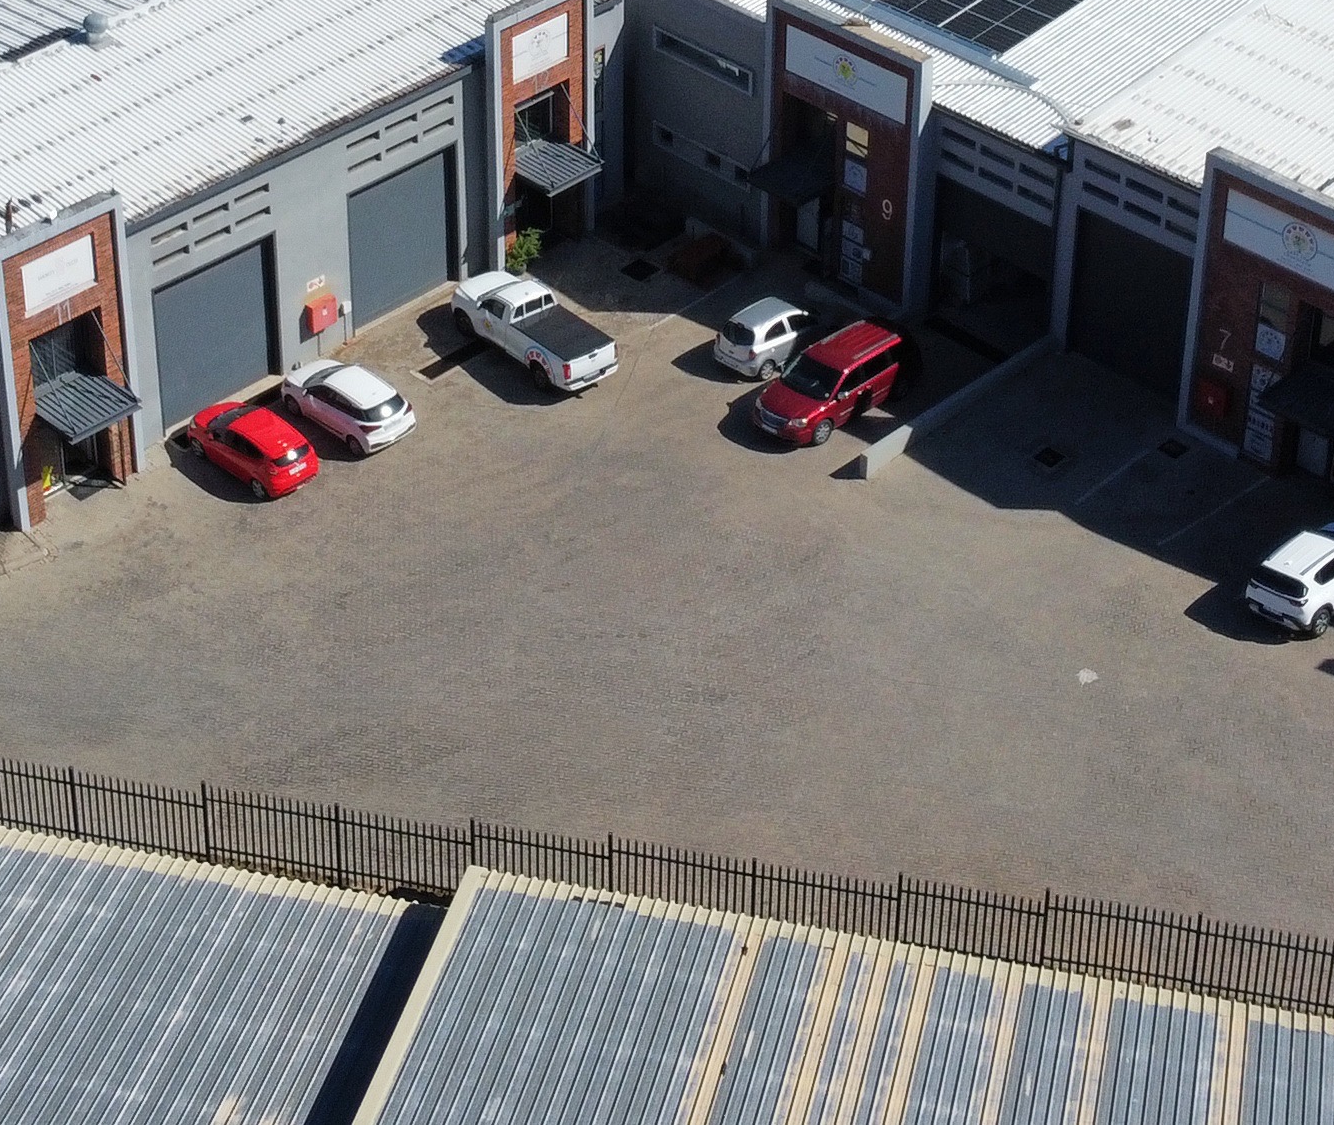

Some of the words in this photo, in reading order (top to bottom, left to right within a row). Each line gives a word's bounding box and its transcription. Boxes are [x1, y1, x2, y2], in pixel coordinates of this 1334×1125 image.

[532, 70, 549, 94] 12
[881, 198, 893, 220] 9
[53, 299, 72, 325] 11
[1219, 328, 1232, 350] 7
